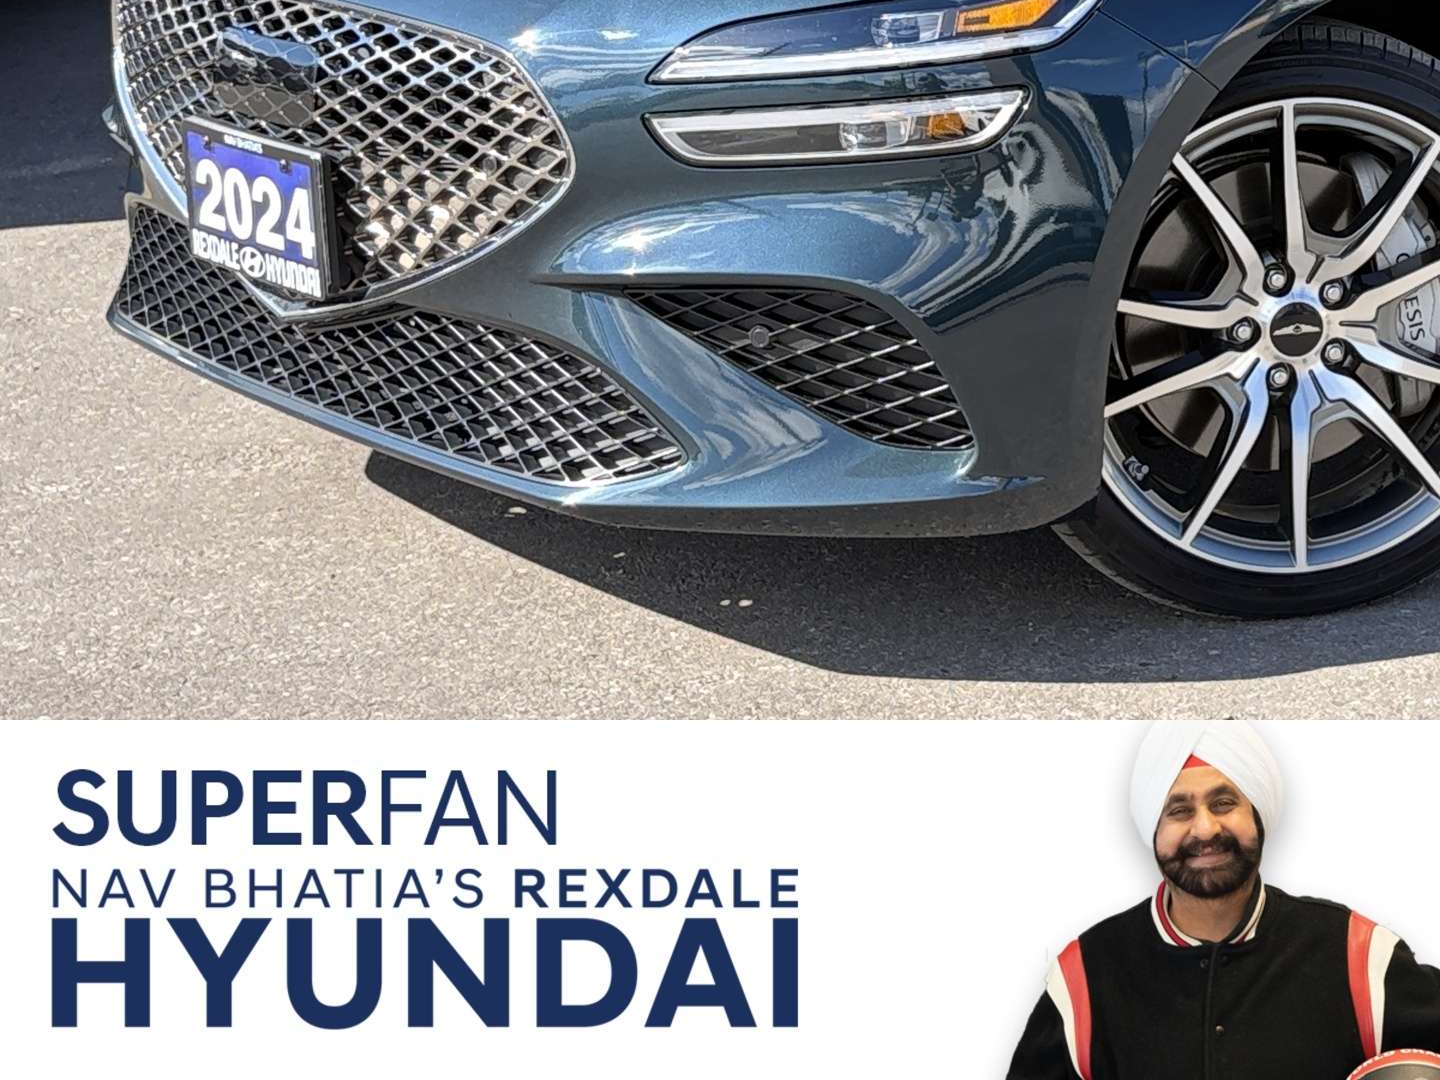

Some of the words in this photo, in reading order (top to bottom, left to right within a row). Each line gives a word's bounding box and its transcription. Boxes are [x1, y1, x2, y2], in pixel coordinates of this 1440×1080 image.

[195, 158, 316, 260] 2024
[192, 228, 241, 270] REXDALE
[265, 257, 322, 297] HYUNDAI
